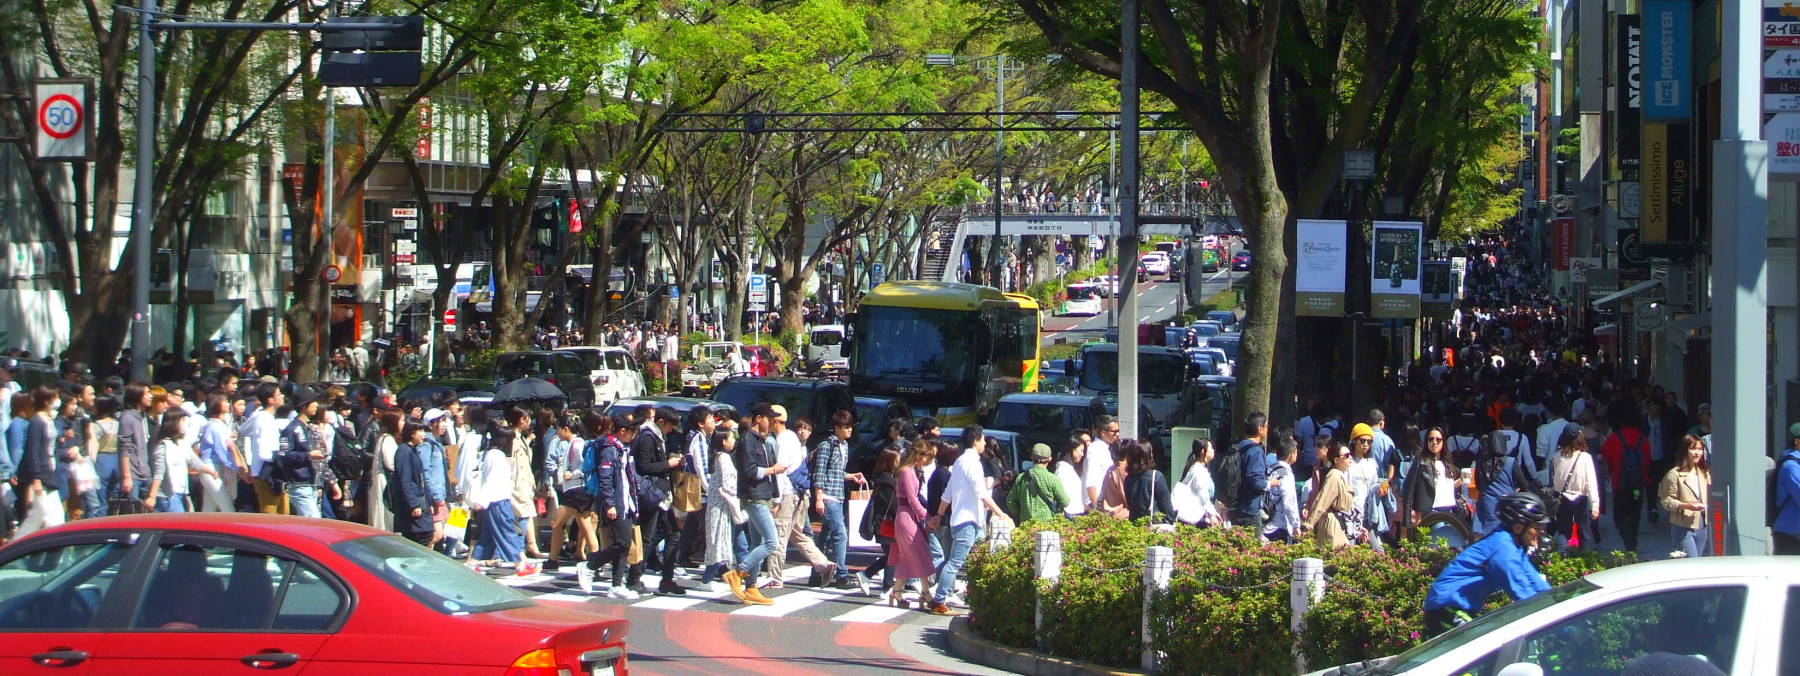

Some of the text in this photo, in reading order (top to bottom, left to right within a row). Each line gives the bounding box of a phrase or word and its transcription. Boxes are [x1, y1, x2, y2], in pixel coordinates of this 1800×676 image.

[1661, 10, 1674, 105] ICE MONSTER
[48, 107, 73, 126] 50
[1649, 141, 1661, 224] Settimissimo
[1671, 159, 1687, 208] Alluge
[751, 276, 765, 290] P
